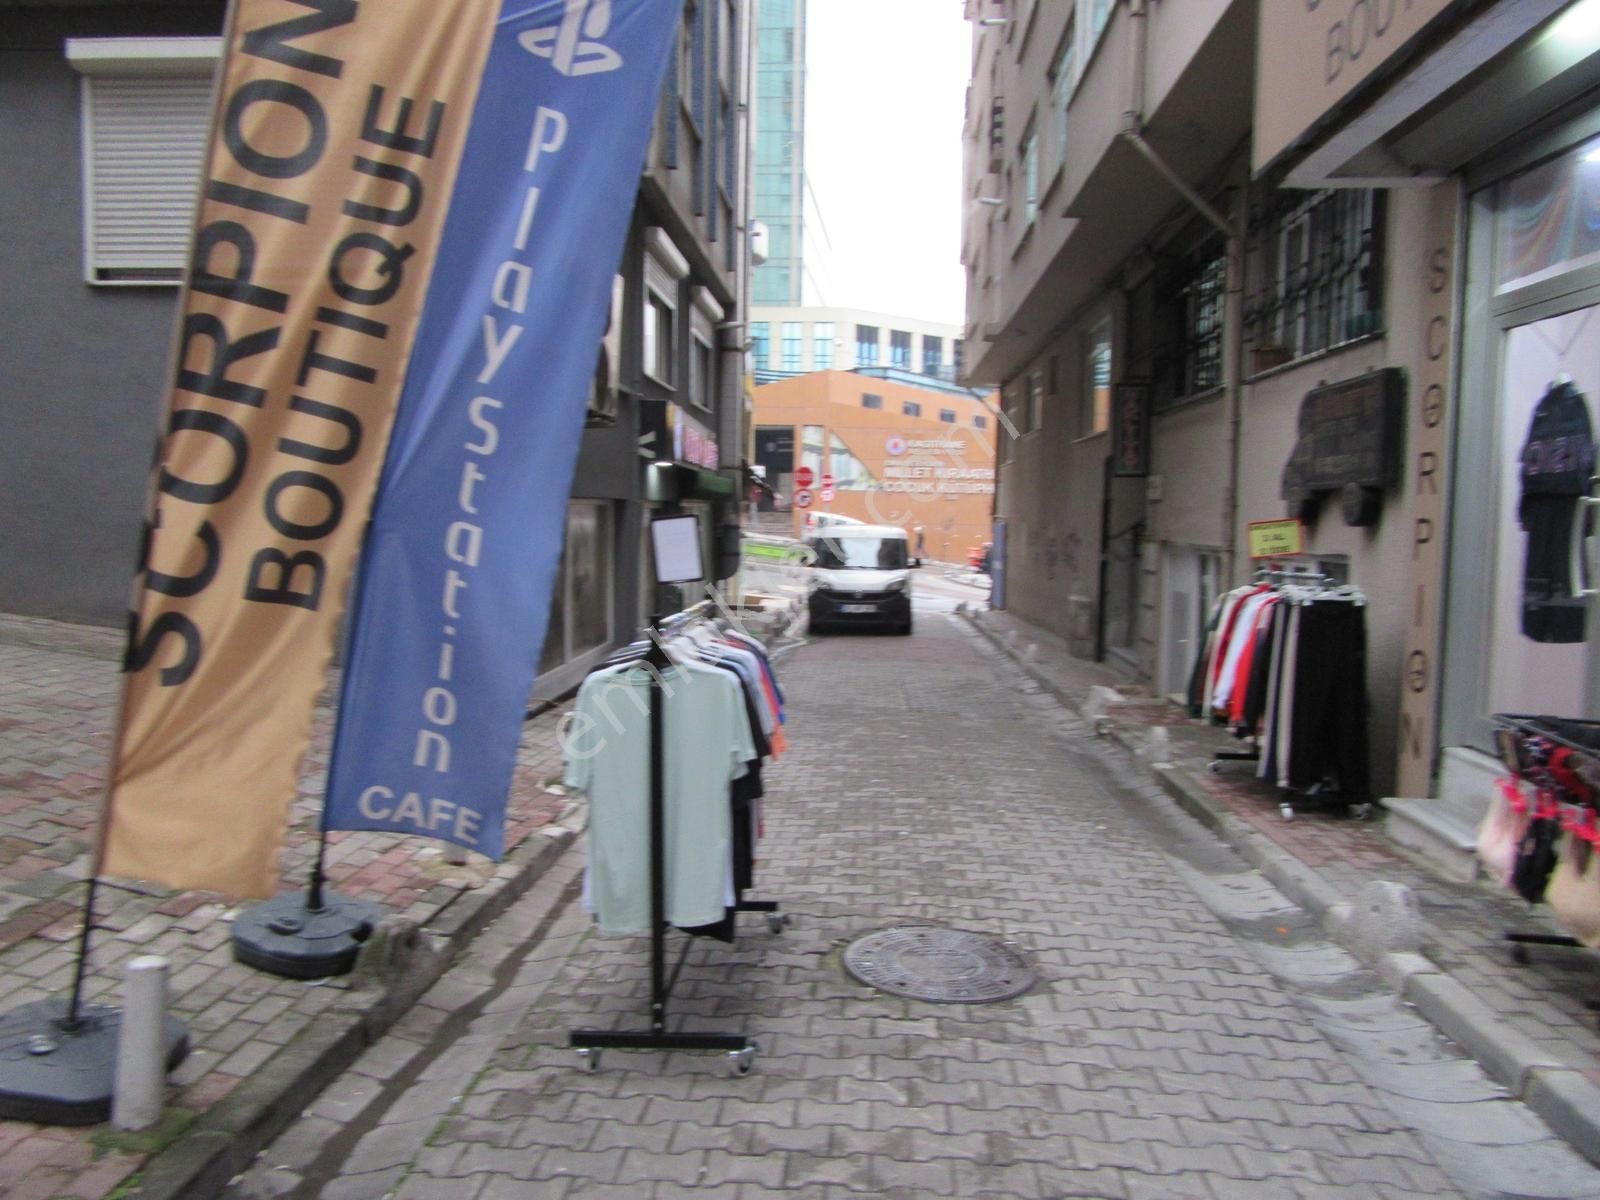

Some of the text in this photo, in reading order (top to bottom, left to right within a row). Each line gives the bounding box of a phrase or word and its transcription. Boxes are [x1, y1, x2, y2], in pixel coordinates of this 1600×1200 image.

[122, 0, 359, 687] SCORPION
[244, 84, 446, 611] BOUTIQUE
[358, 785, 483, 845] CAFE
